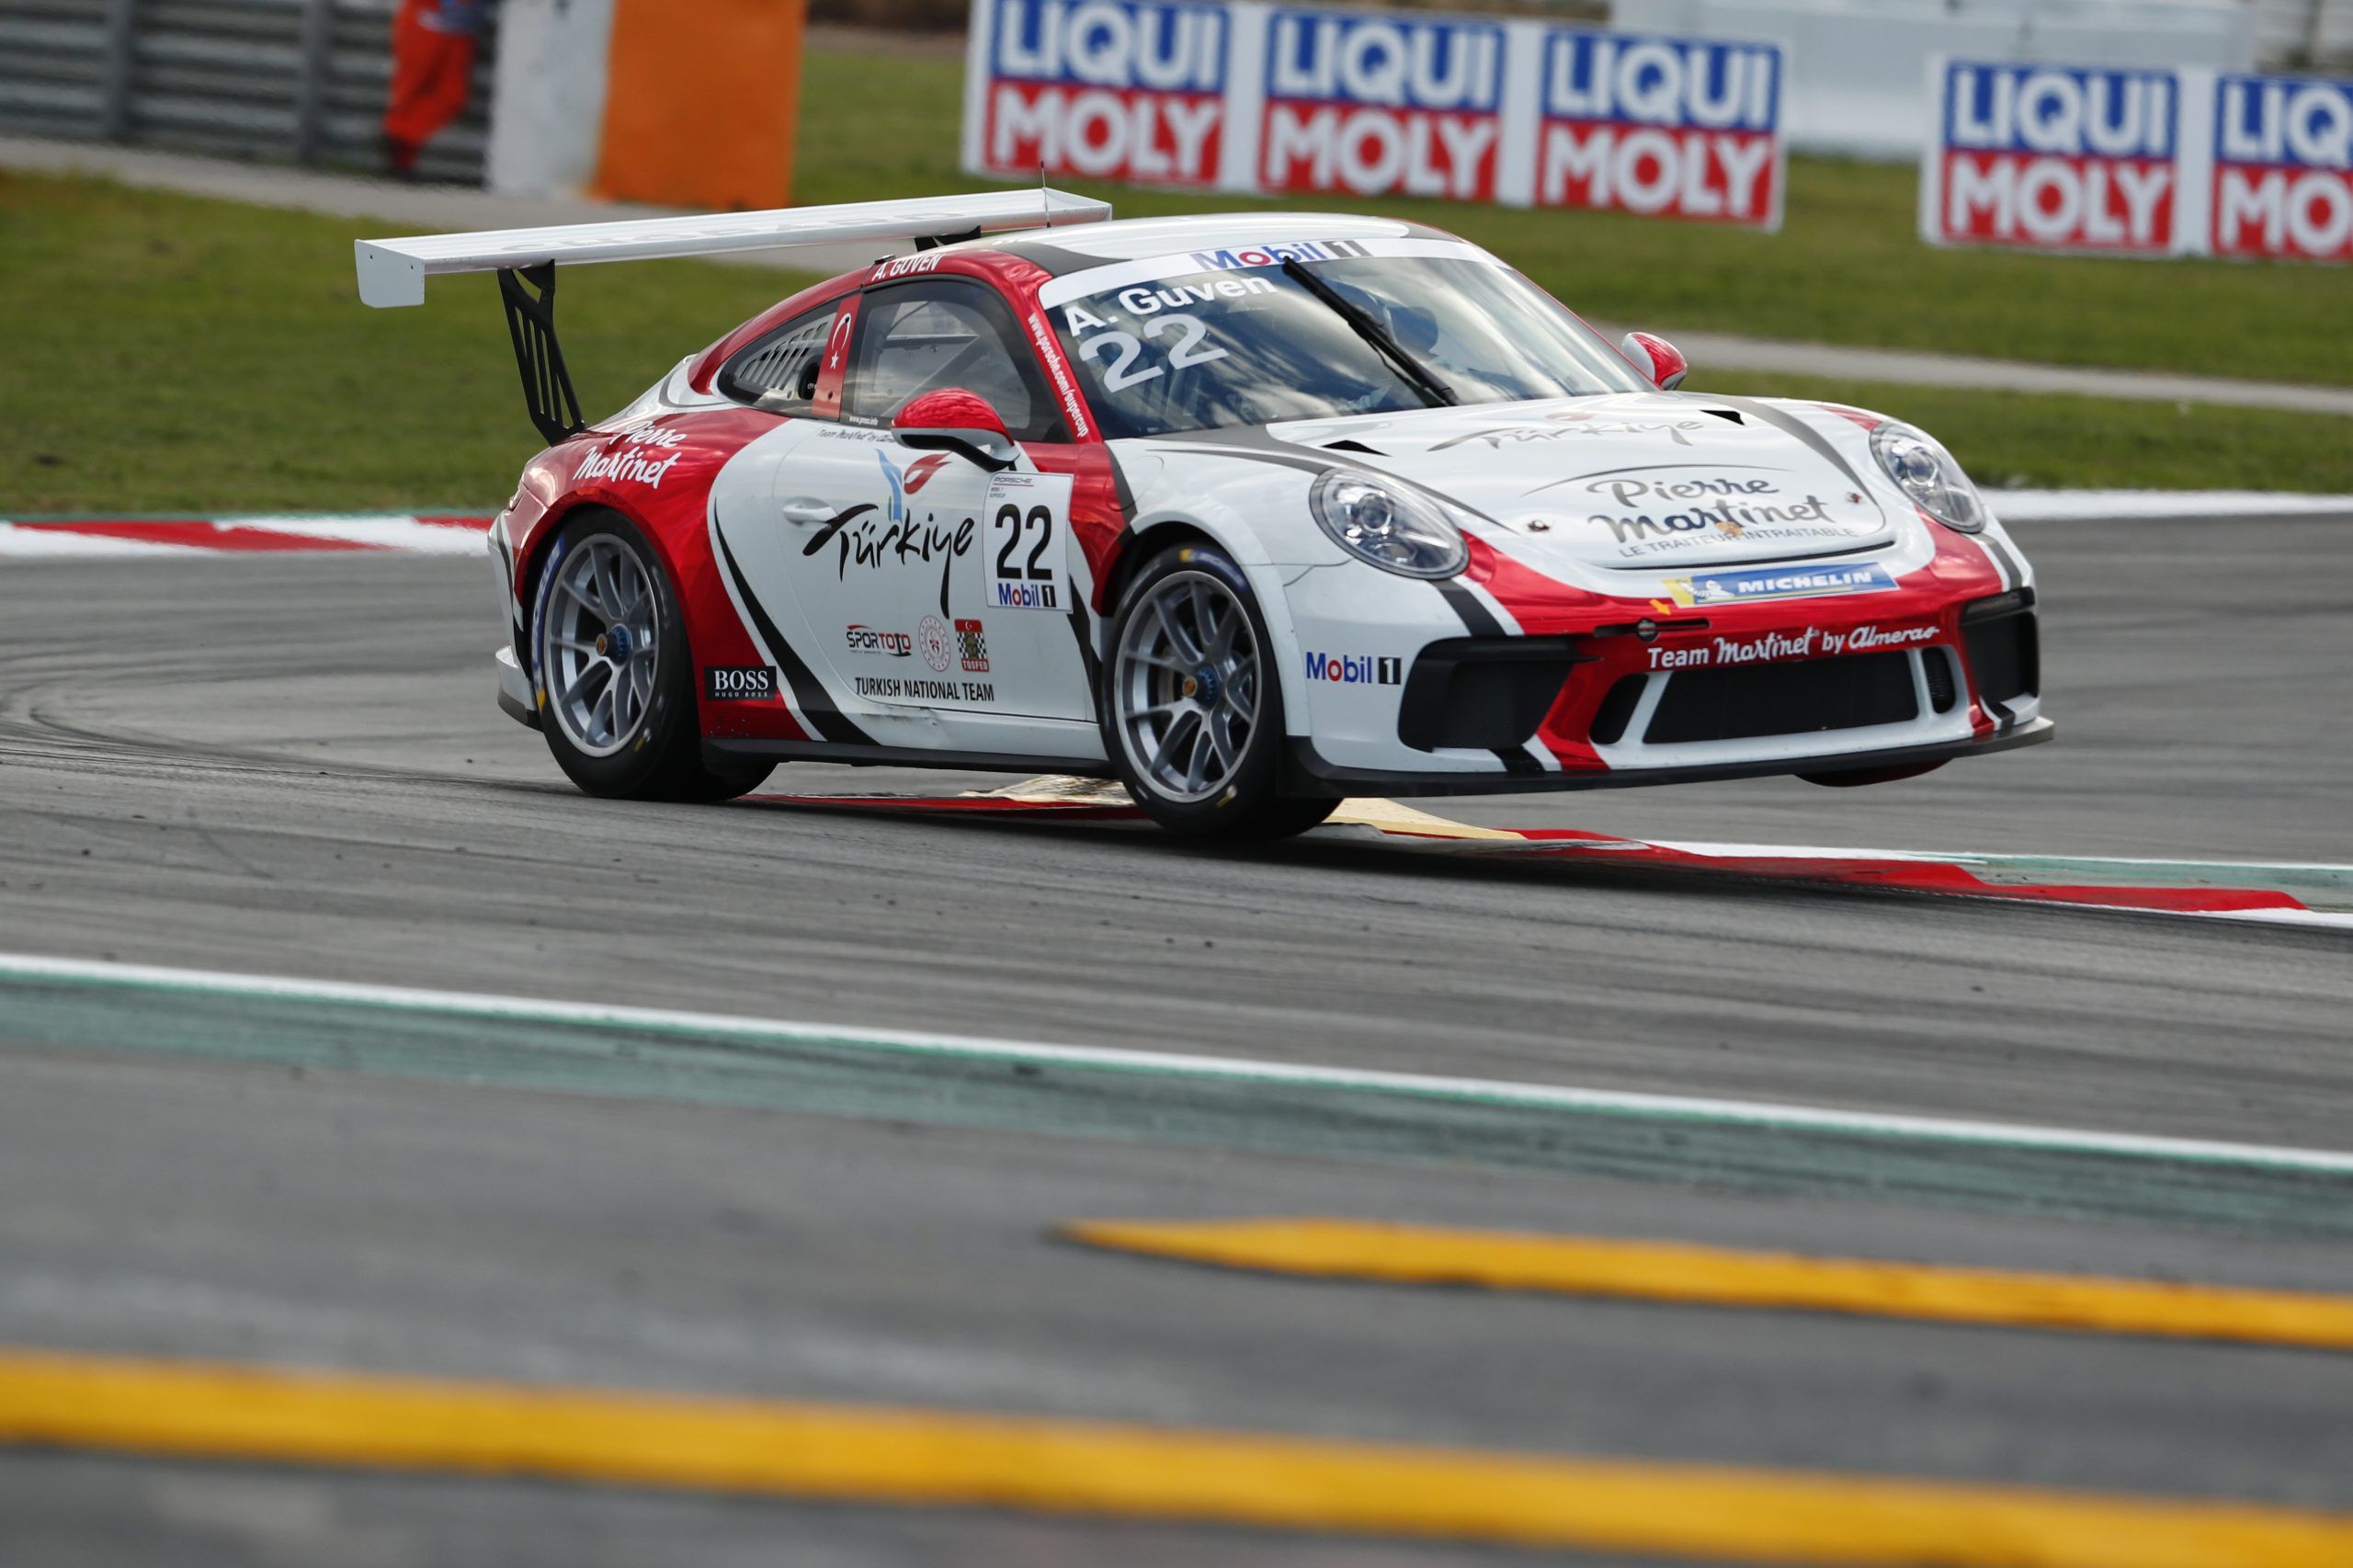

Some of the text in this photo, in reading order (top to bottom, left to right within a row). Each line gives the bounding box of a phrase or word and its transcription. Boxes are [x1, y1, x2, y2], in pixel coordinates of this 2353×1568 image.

[998, 0, 1222, 89] LIQUI
[1278, 18, 1498, 108] LIQUI
[1551, 40, 1772, 127] LIQUI
[994, 87, 1220, 176] MOLY
[1952, 68, 2169, 153] LIQUI
[1267, 106, 1493, 199] MOLY
[1544, 125, 1768, 217] MOLY
[1949, 156, 2169, 244] MOLY
[871, 261, 889, 281] A.
[1189, 242, 1327, 271] Mobil
[1064, 276, 1278, 337] A. Guven
[1028, 312, 1089, 437] www.porsche.com/supercup
[1078, 312, 1230, 394] 22
[609, 420, 688, 448] Pierre
[1426, 420, 1705, 450] Türkiye
[573, 445, 682, 489] Martinet
[1586, 478, 1780, 508] Pierre
[995, 504, 1052, 580] 22
[1587, 494, 1836, 544] Martinet
[802, 504, 976, 619] Türkiye
[1618, 527, 1860, 559] LE TRAITEUR INTRAITABLE
[998, 583, 1040, 608] Mobil
[1737, 572, 1872, 594] MICHELIN
[963, 660, 988, 671] TOSFED
[1306, 652, 1372, 684] Mobil
[1647, 626, 1941, 669] Team Martinet by Almeras
[714, 670, 768, 690] BOSS
[855, 676, 995, 702] TURKISH NATIONAL TEAM
